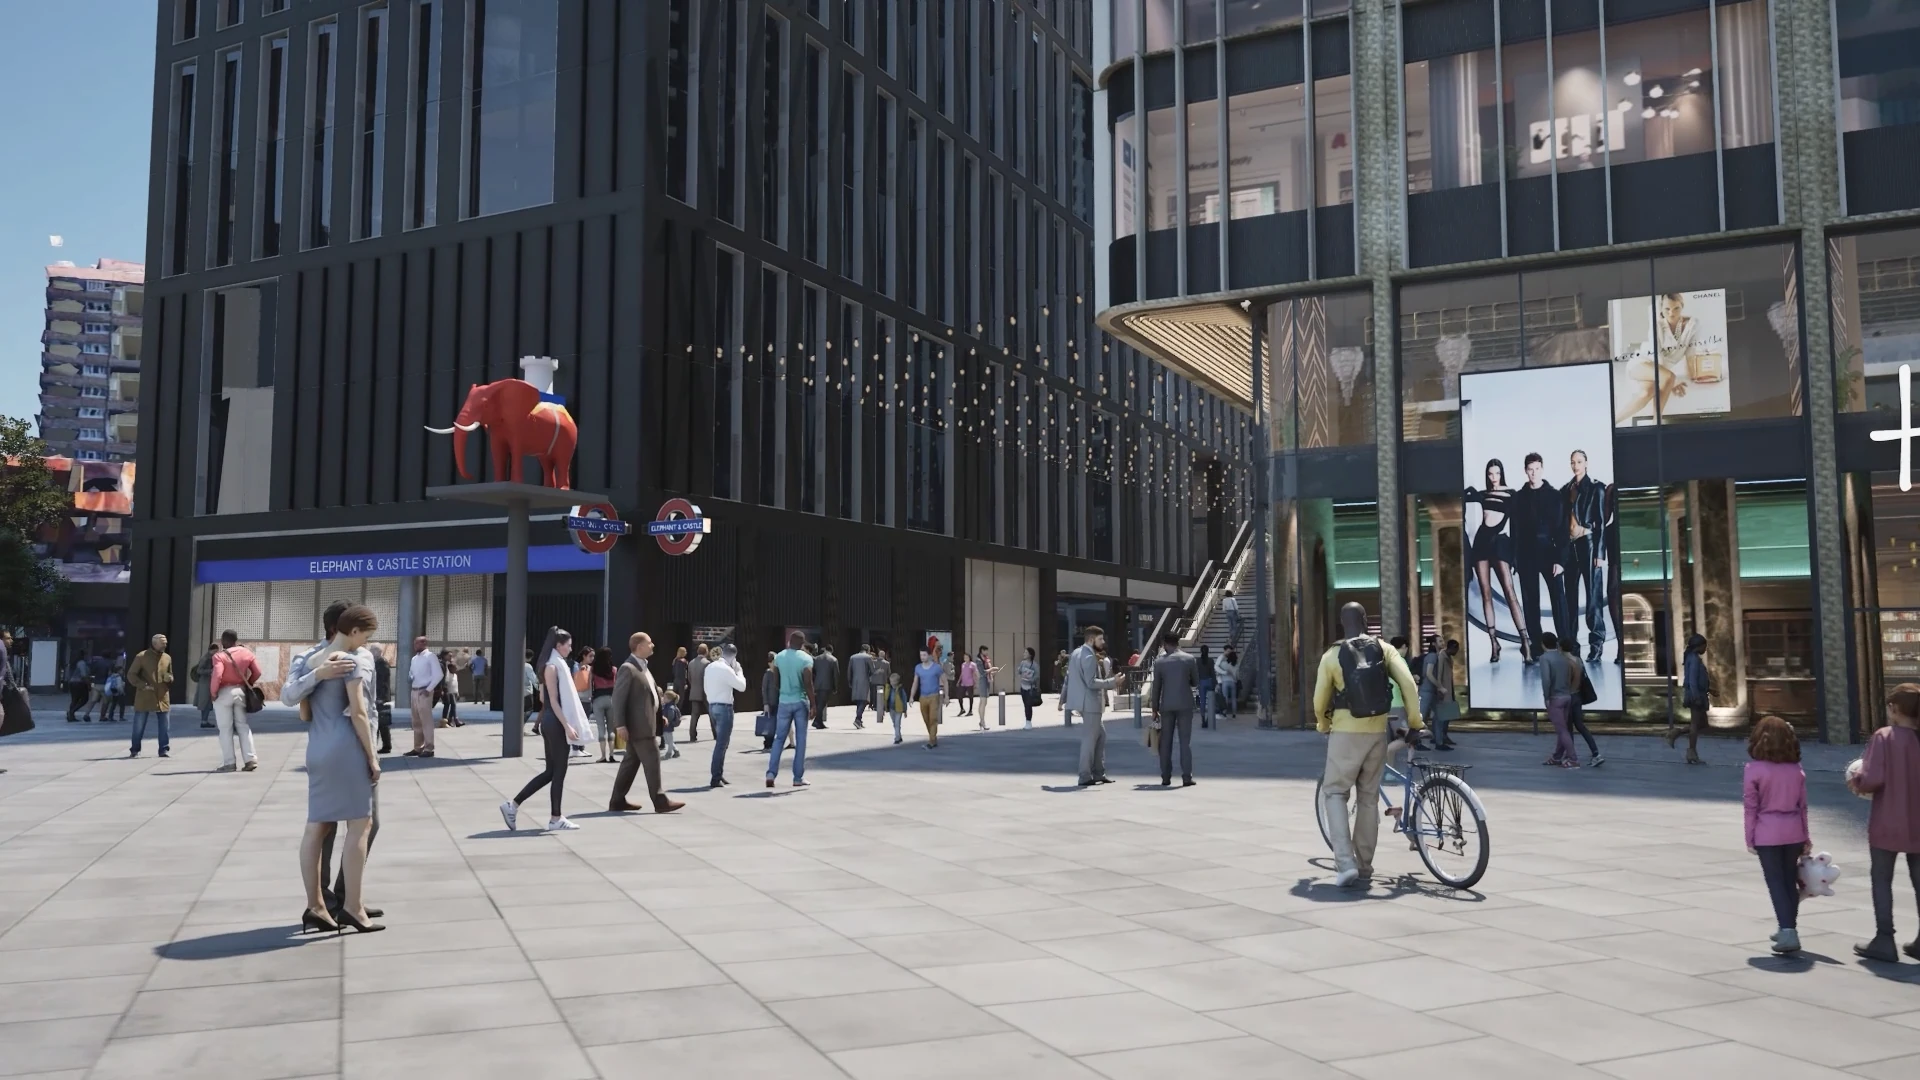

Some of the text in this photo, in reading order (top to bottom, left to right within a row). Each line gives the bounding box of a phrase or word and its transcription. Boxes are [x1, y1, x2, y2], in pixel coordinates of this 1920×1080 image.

[1692, 292, 1721, 300] CHANEL
[651, 523, 677, 532] ELEPHANT
[682, 522, 702, 530] CASTLE
[310, 555, 471, 573] ELEPHANT & CASTLE STATION
